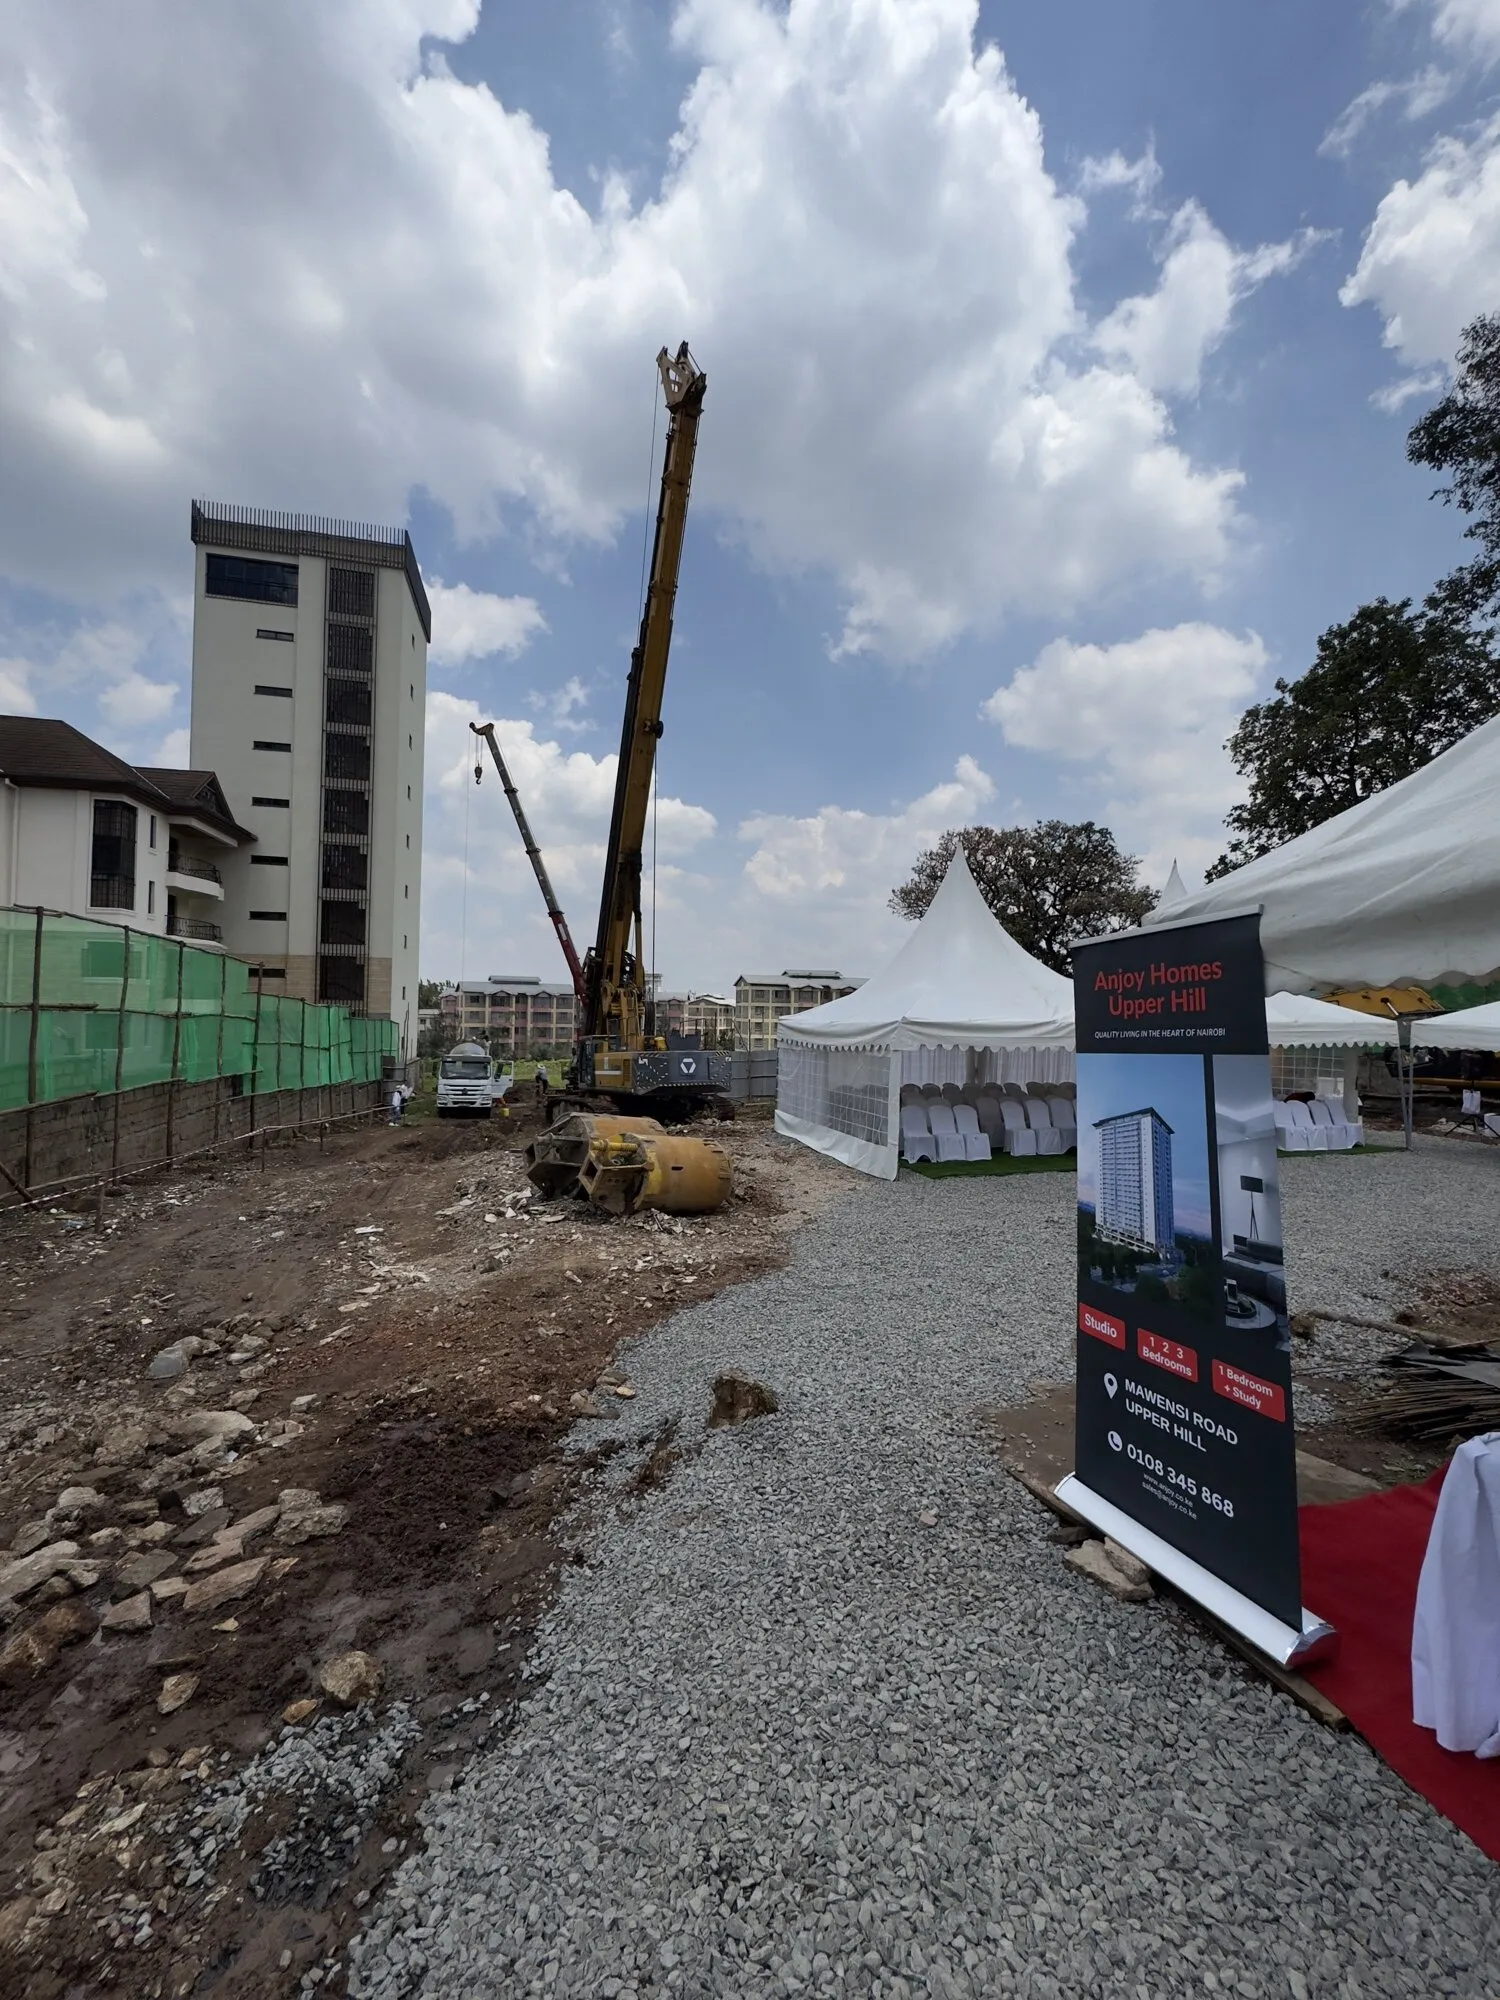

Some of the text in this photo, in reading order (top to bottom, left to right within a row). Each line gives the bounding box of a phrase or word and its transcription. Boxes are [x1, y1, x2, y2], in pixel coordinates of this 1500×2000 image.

[1094, 961, 1222, 992] Anjoy Homes
[1109, 987, 1206, 1019] Upper Hill
[1095, 1031, 1119, 1039] QUALITY
[1120, 1030, 1140, 1038] LIVING
[1162, 1029, 1184, 1037] HEART
[1197, 1028, 1225, 1036] NAIROBI
[1085, 1314, 1117, 1338] Studio
[1143, 1346, 1192, 1376] Bedrooms
[1150, 1337, 1183, 1358] 1 2 3
[1219, 1365, 1273, 1397] 1 Bedroom
[1125, 1379, 1237, 1445] MAWENSI ROAD
[1233, 1386, 1261, 1409] Study
[1126, 1399, 1206, 1452] UPPER HILL
[1127, 1444, 1234, 1517] 0108 345 868
